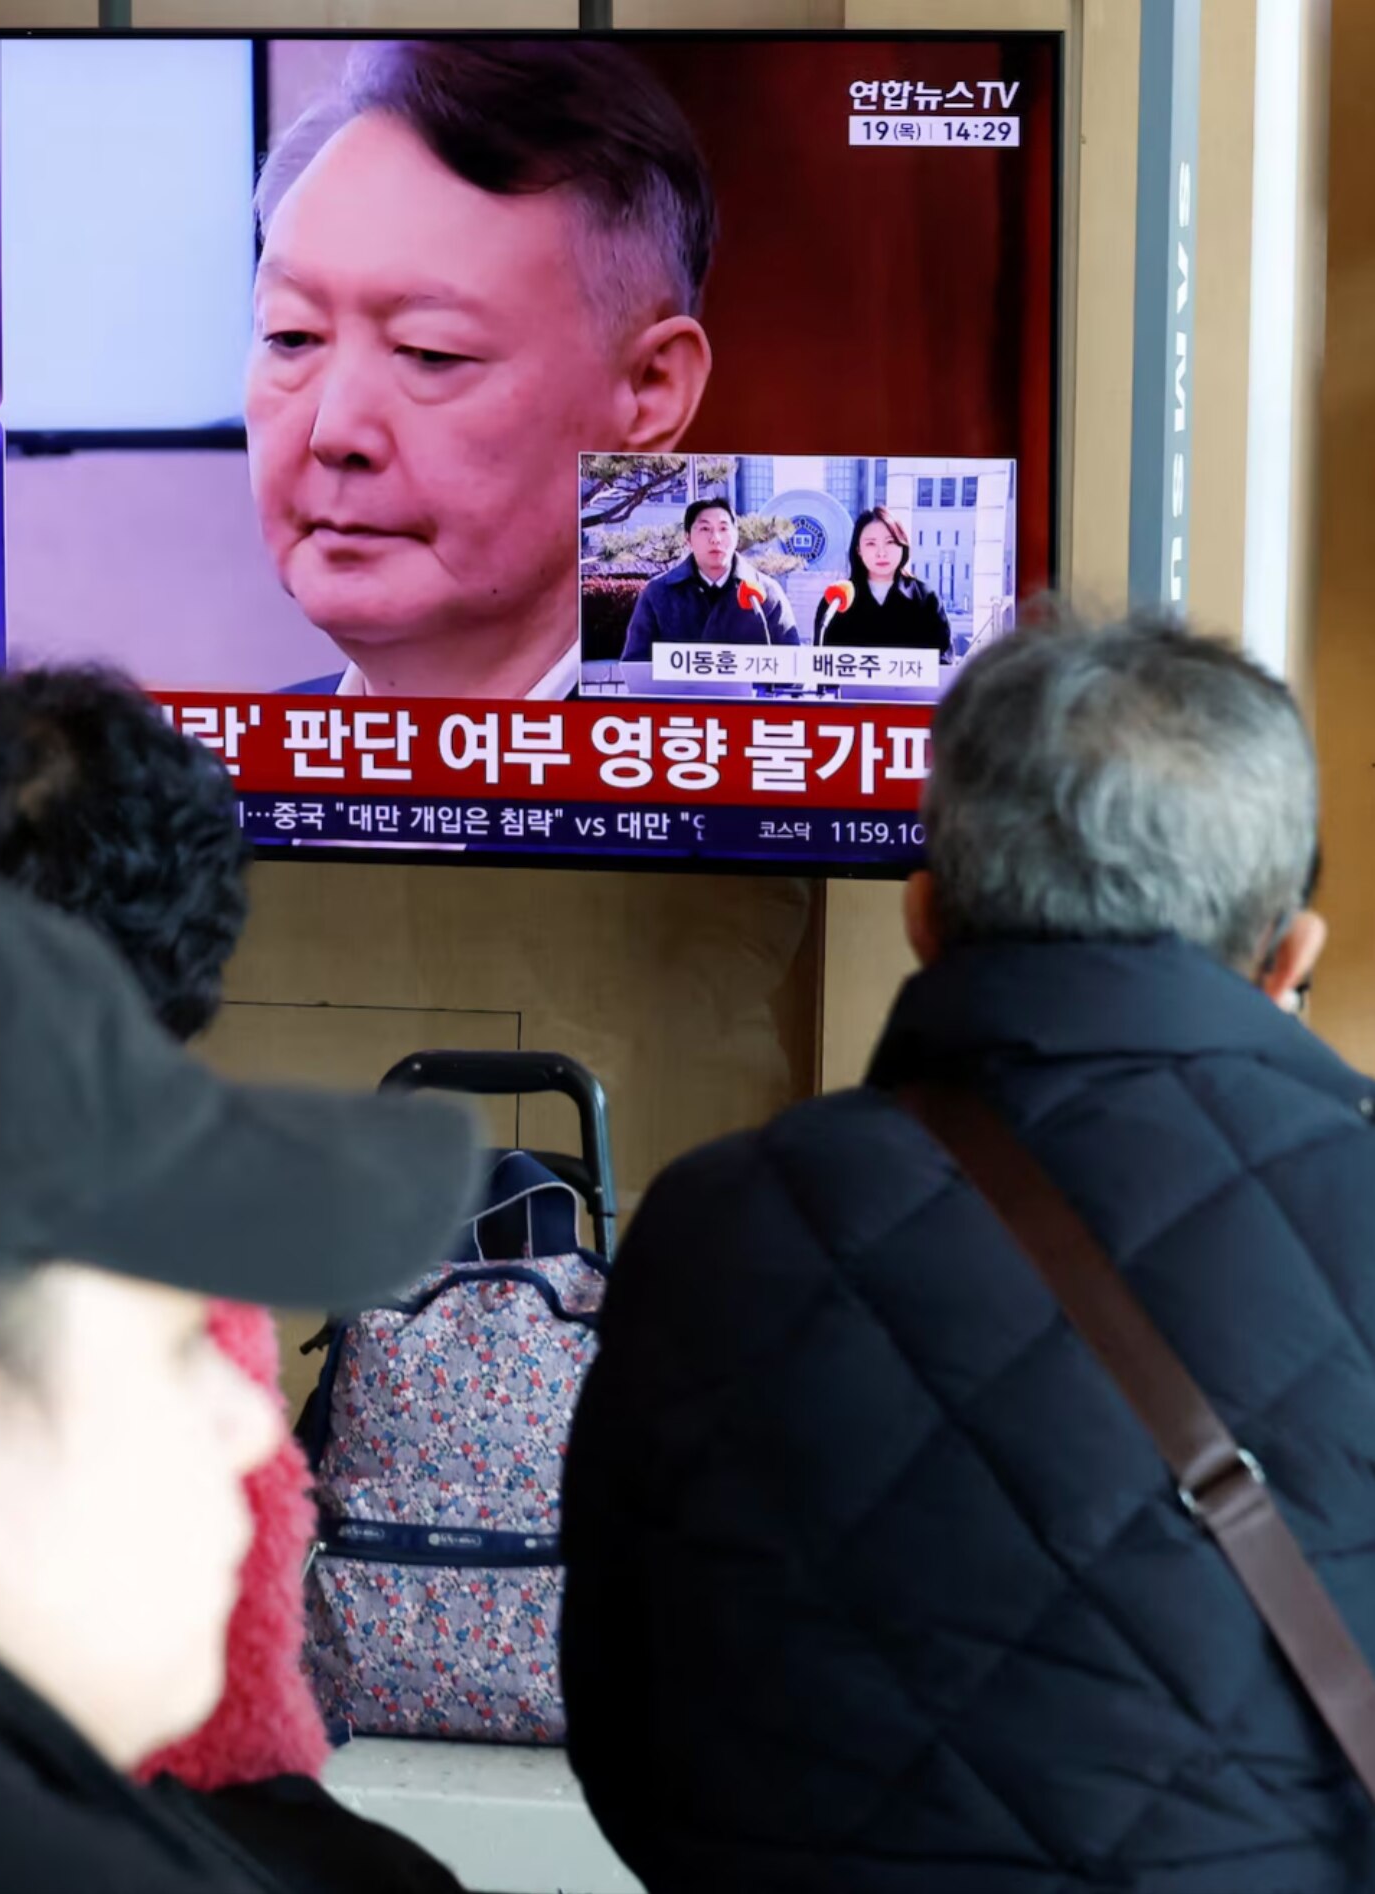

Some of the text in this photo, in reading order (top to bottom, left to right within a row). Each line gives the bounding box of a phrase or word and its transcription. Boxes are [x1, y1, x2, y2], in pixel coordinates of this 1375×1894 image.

[849, 80, 1020, 111] 연합뉴스TV
[943, 121, 1012, 141] 14:29
[670, 650, 922, 679] 이동훈 기자 배윤주 기자
[161, 703, 260, 776] 란'
[284, 708, 418, 780] 판단
[438, 712, 571, 785] 여부
[590, 716, 727, 790] 영향
[335, 802, 401, 833] "대만
[410, 806, 490, 835] 개입은
[499, 807, 563, 837] 침략"
[575, 817, 606, 837] vs
[616, 812, 670, 840] 대만
[758, 821, 811, 841] 코스닥
